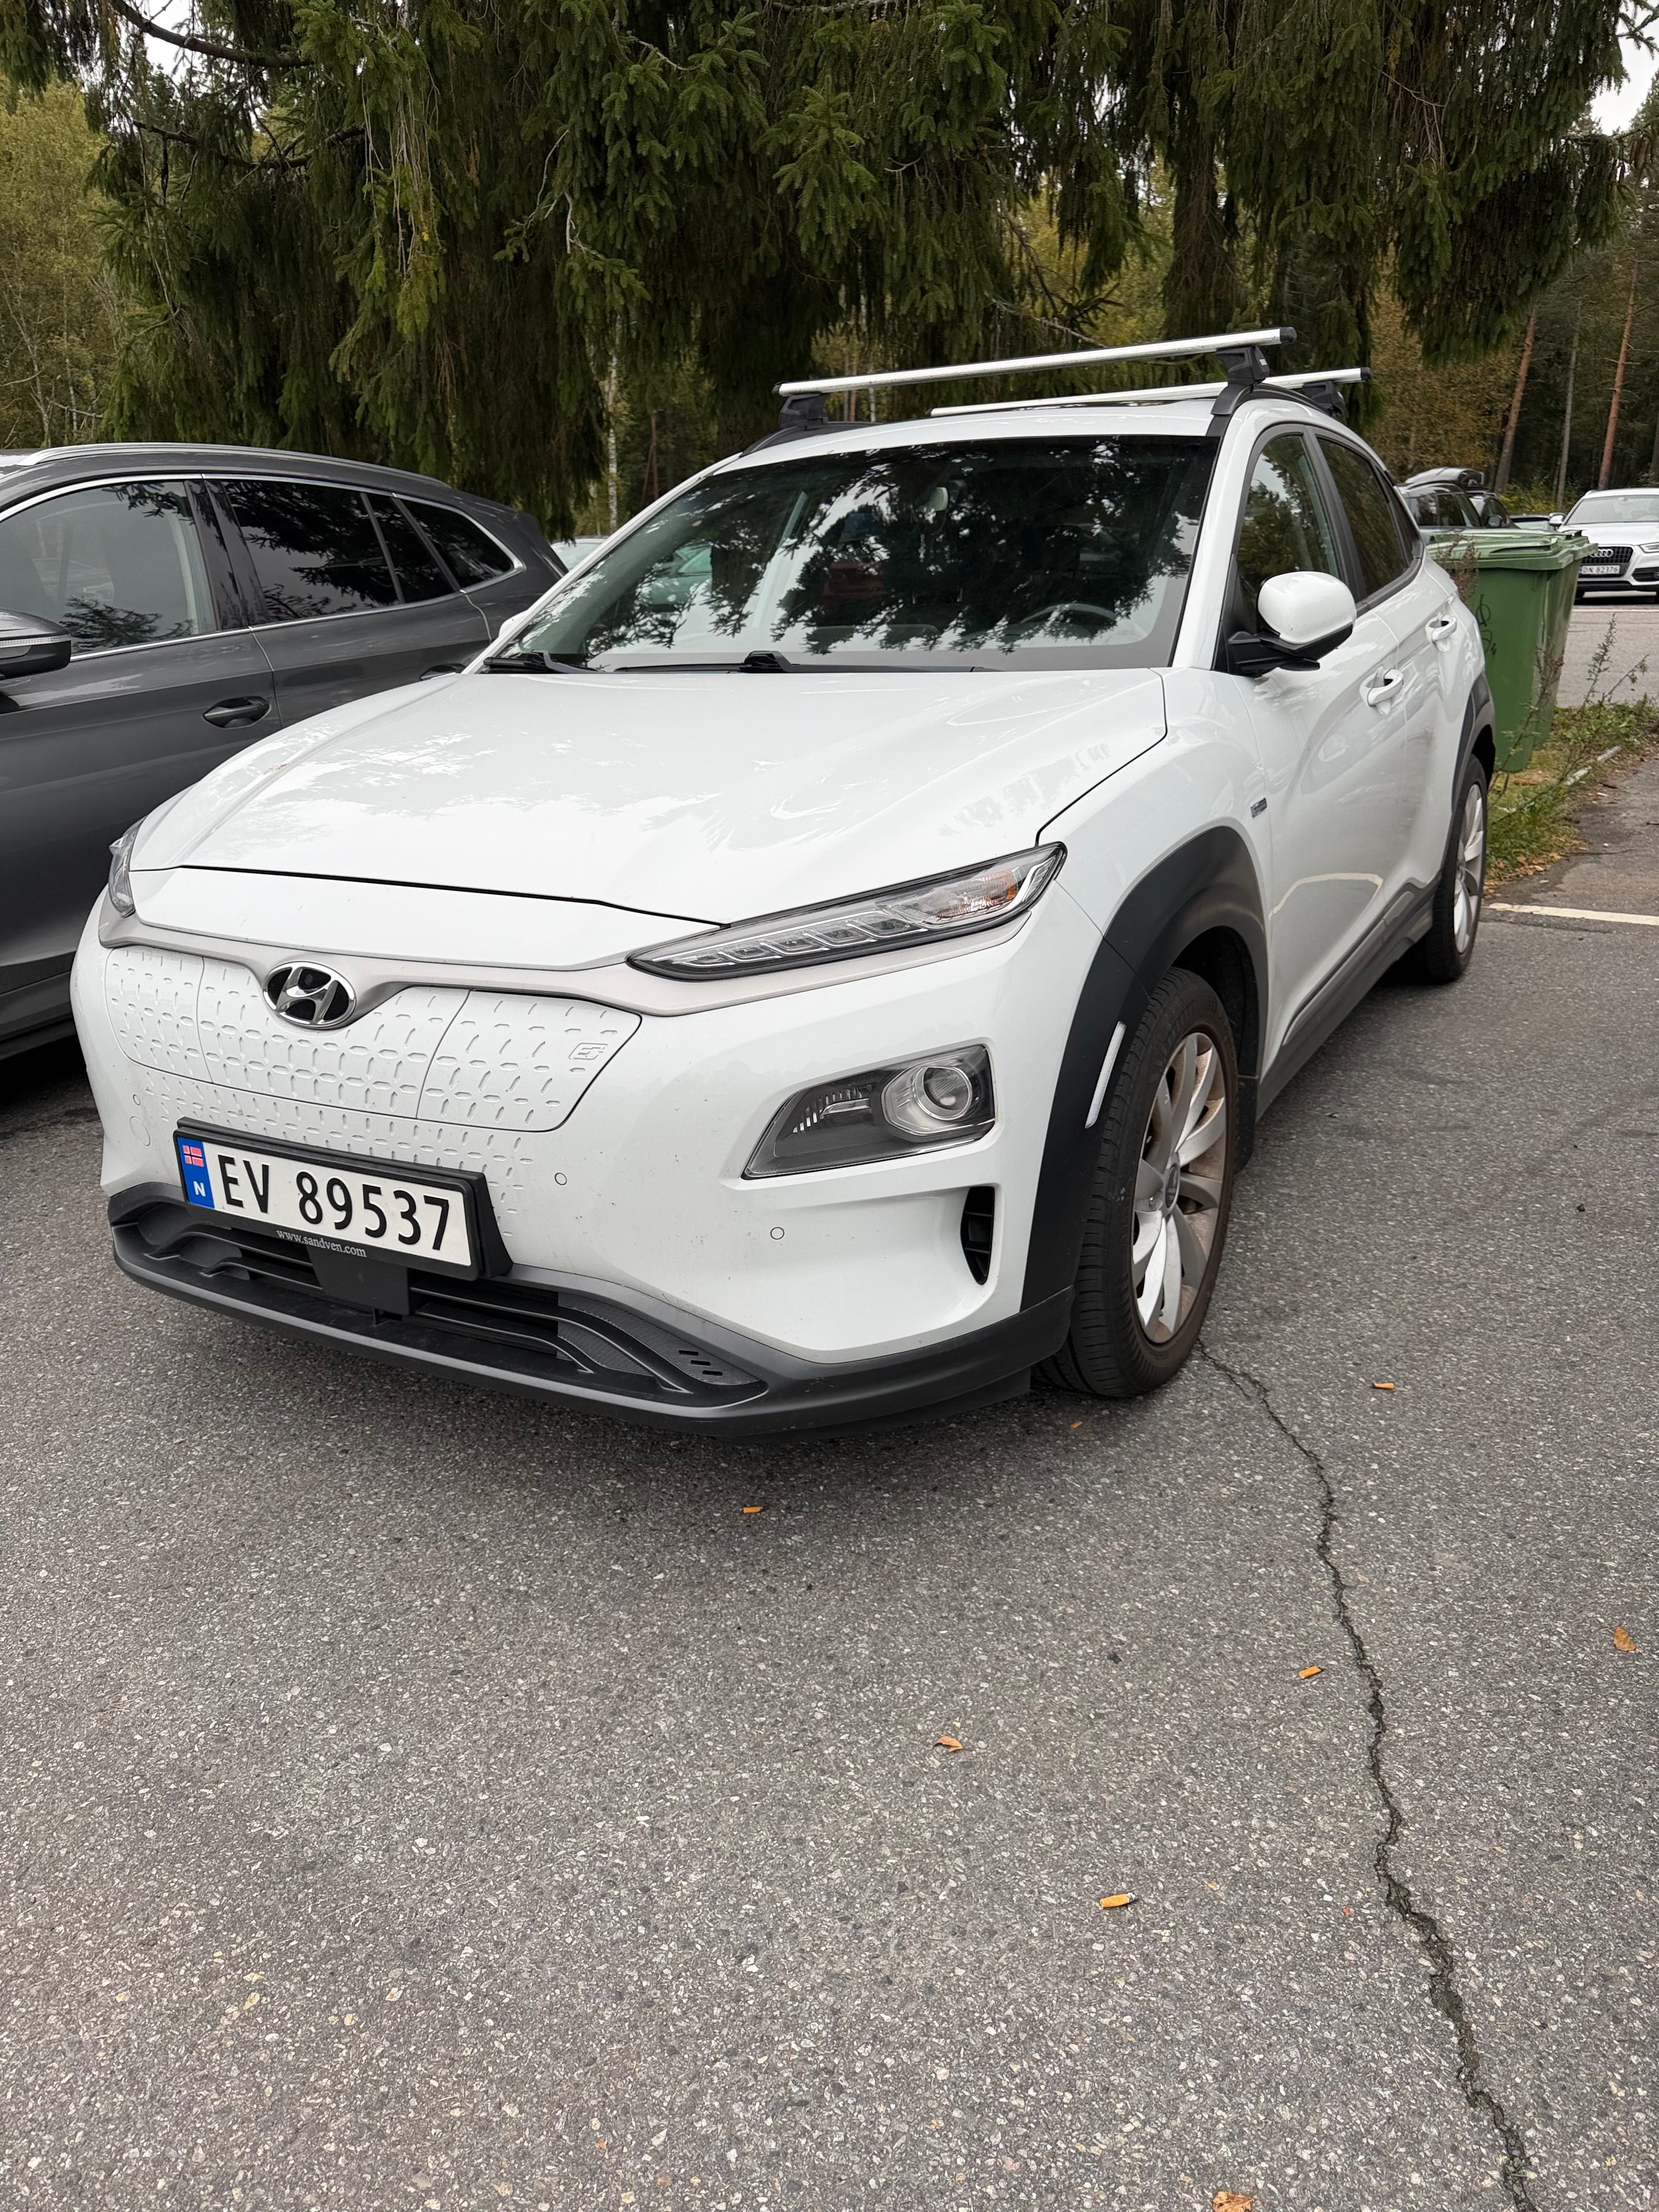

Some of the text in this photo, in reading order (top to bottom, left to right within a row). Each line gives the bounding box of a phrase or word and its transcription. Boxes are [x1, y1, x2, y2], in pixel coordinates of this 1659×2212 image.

[193, 1181, 206, 1197] N
[218, 1154, 449, 1250] EV 89537
[276, 1230, 367, 1257] www.sandven.com
